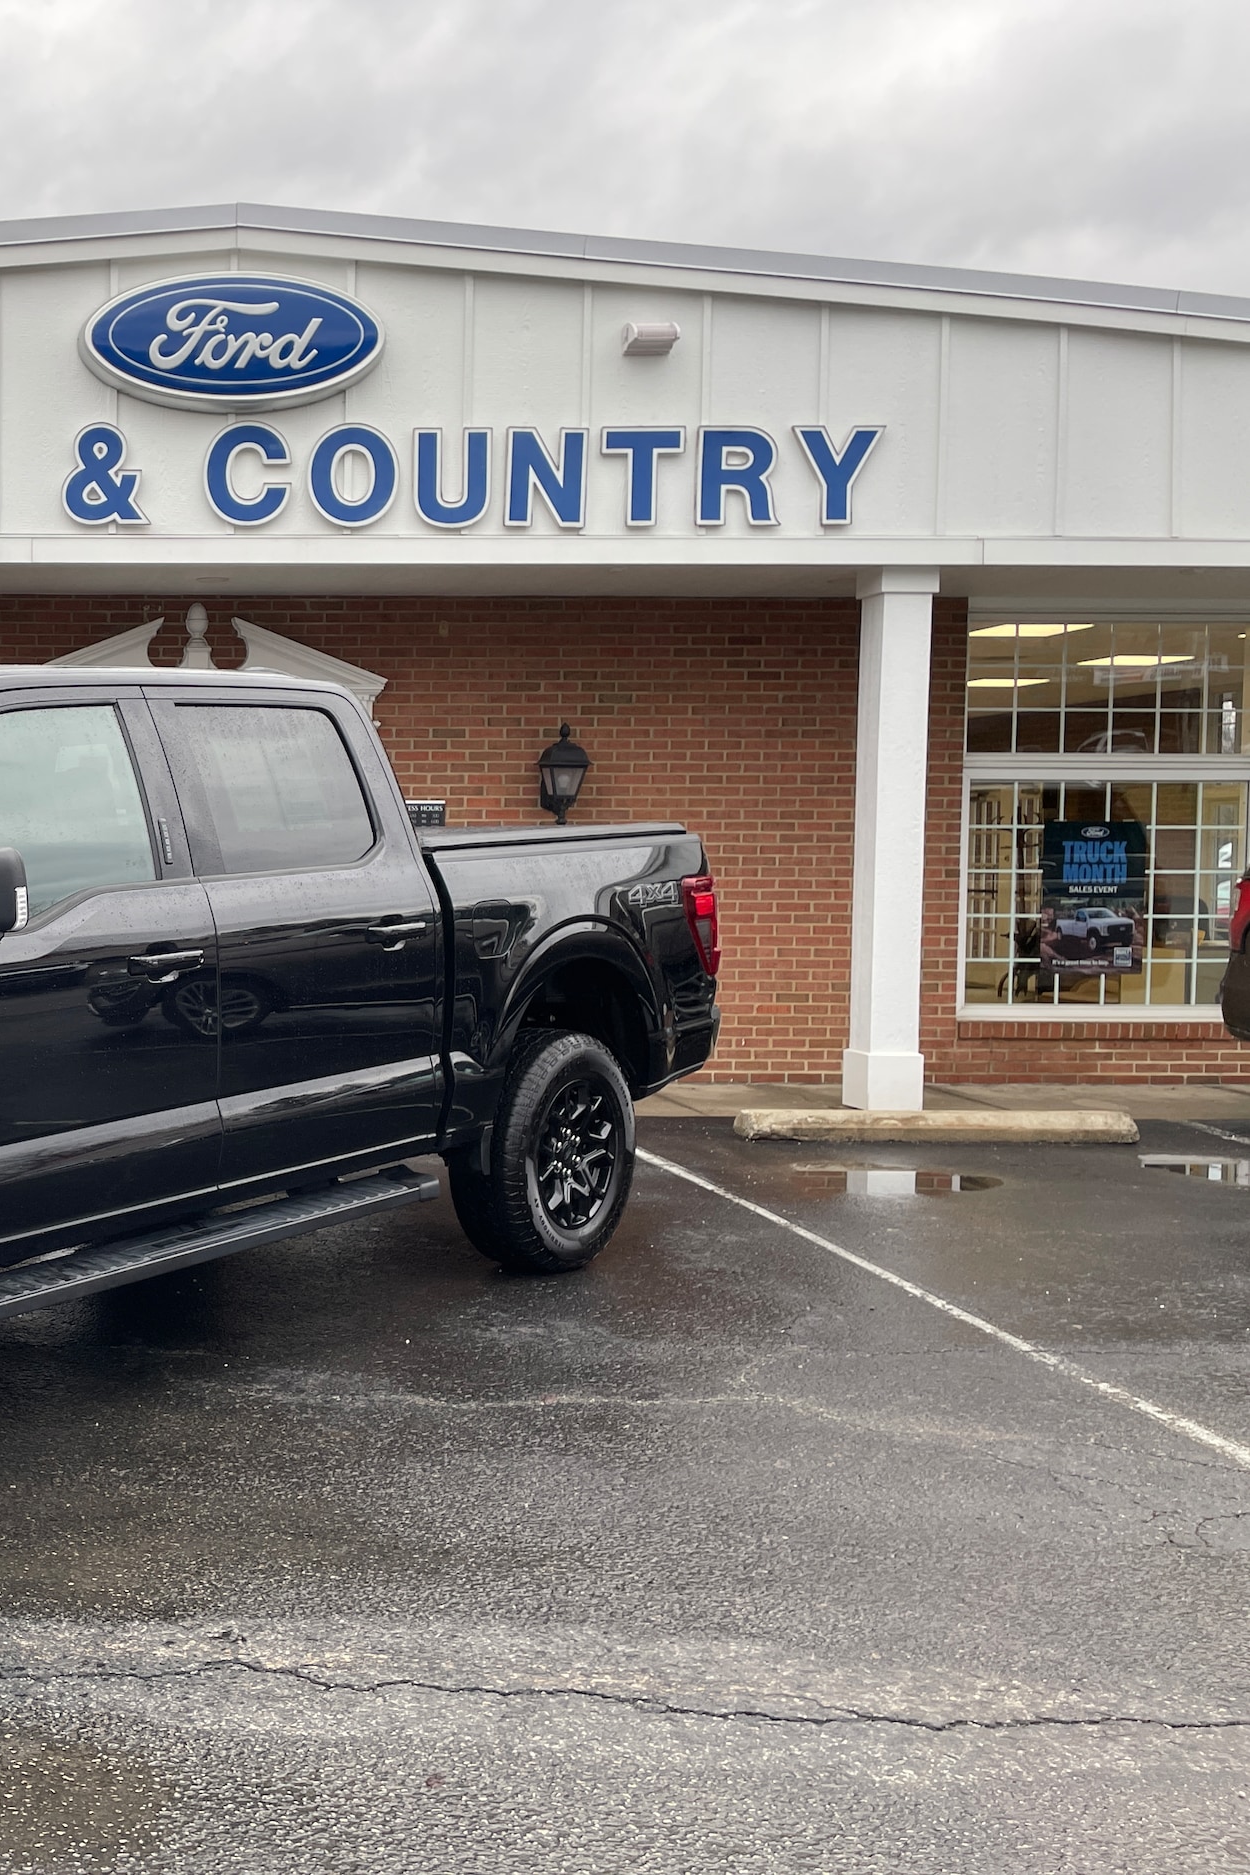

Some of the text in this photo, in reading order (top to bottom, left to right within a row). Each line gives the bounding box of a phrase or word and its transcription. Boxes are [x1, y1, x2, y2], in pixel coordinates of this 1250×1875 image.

[149, 298, 324, 370] Ford
[62, 422, 150, 526] &
[203, 421, 887, 528] COUNTRY
[1062, 841, 1127, 863] TRUCK
[1062, 863, 1127, 884] MONTH
[628, 881, 679, 908] 4x4
